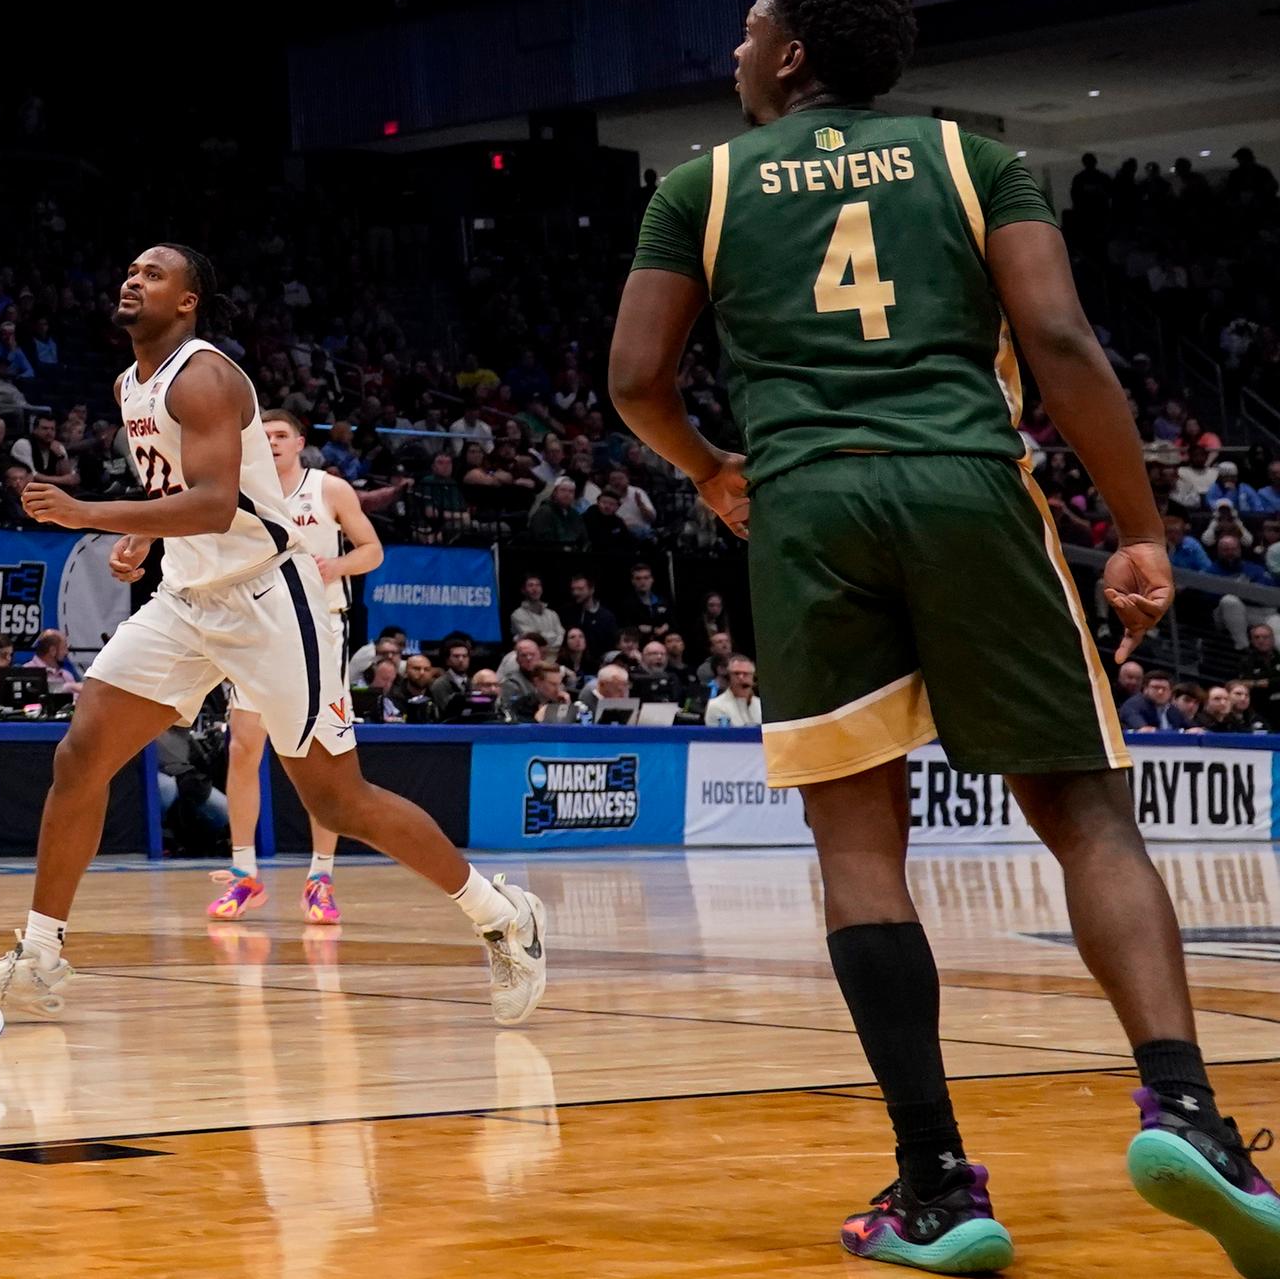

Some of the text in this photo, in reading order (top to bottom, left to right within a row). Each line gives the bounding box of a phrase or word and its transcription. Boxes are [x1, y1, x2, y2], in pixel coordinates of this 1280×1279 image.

[759, 145, 915, 195] STEVENS
[813, 200, 896, 342] 4
[135, 444, 184, 499] 22
[372, 583, 493, 608] #MARCHMADNESS
[546, 763, 608, 792] MARCH
[701, 780, 789, 805] HOSTED BY
[1127, 760, 1255, 825] AYTON
[557, 790, 637, 820] MADNESS
